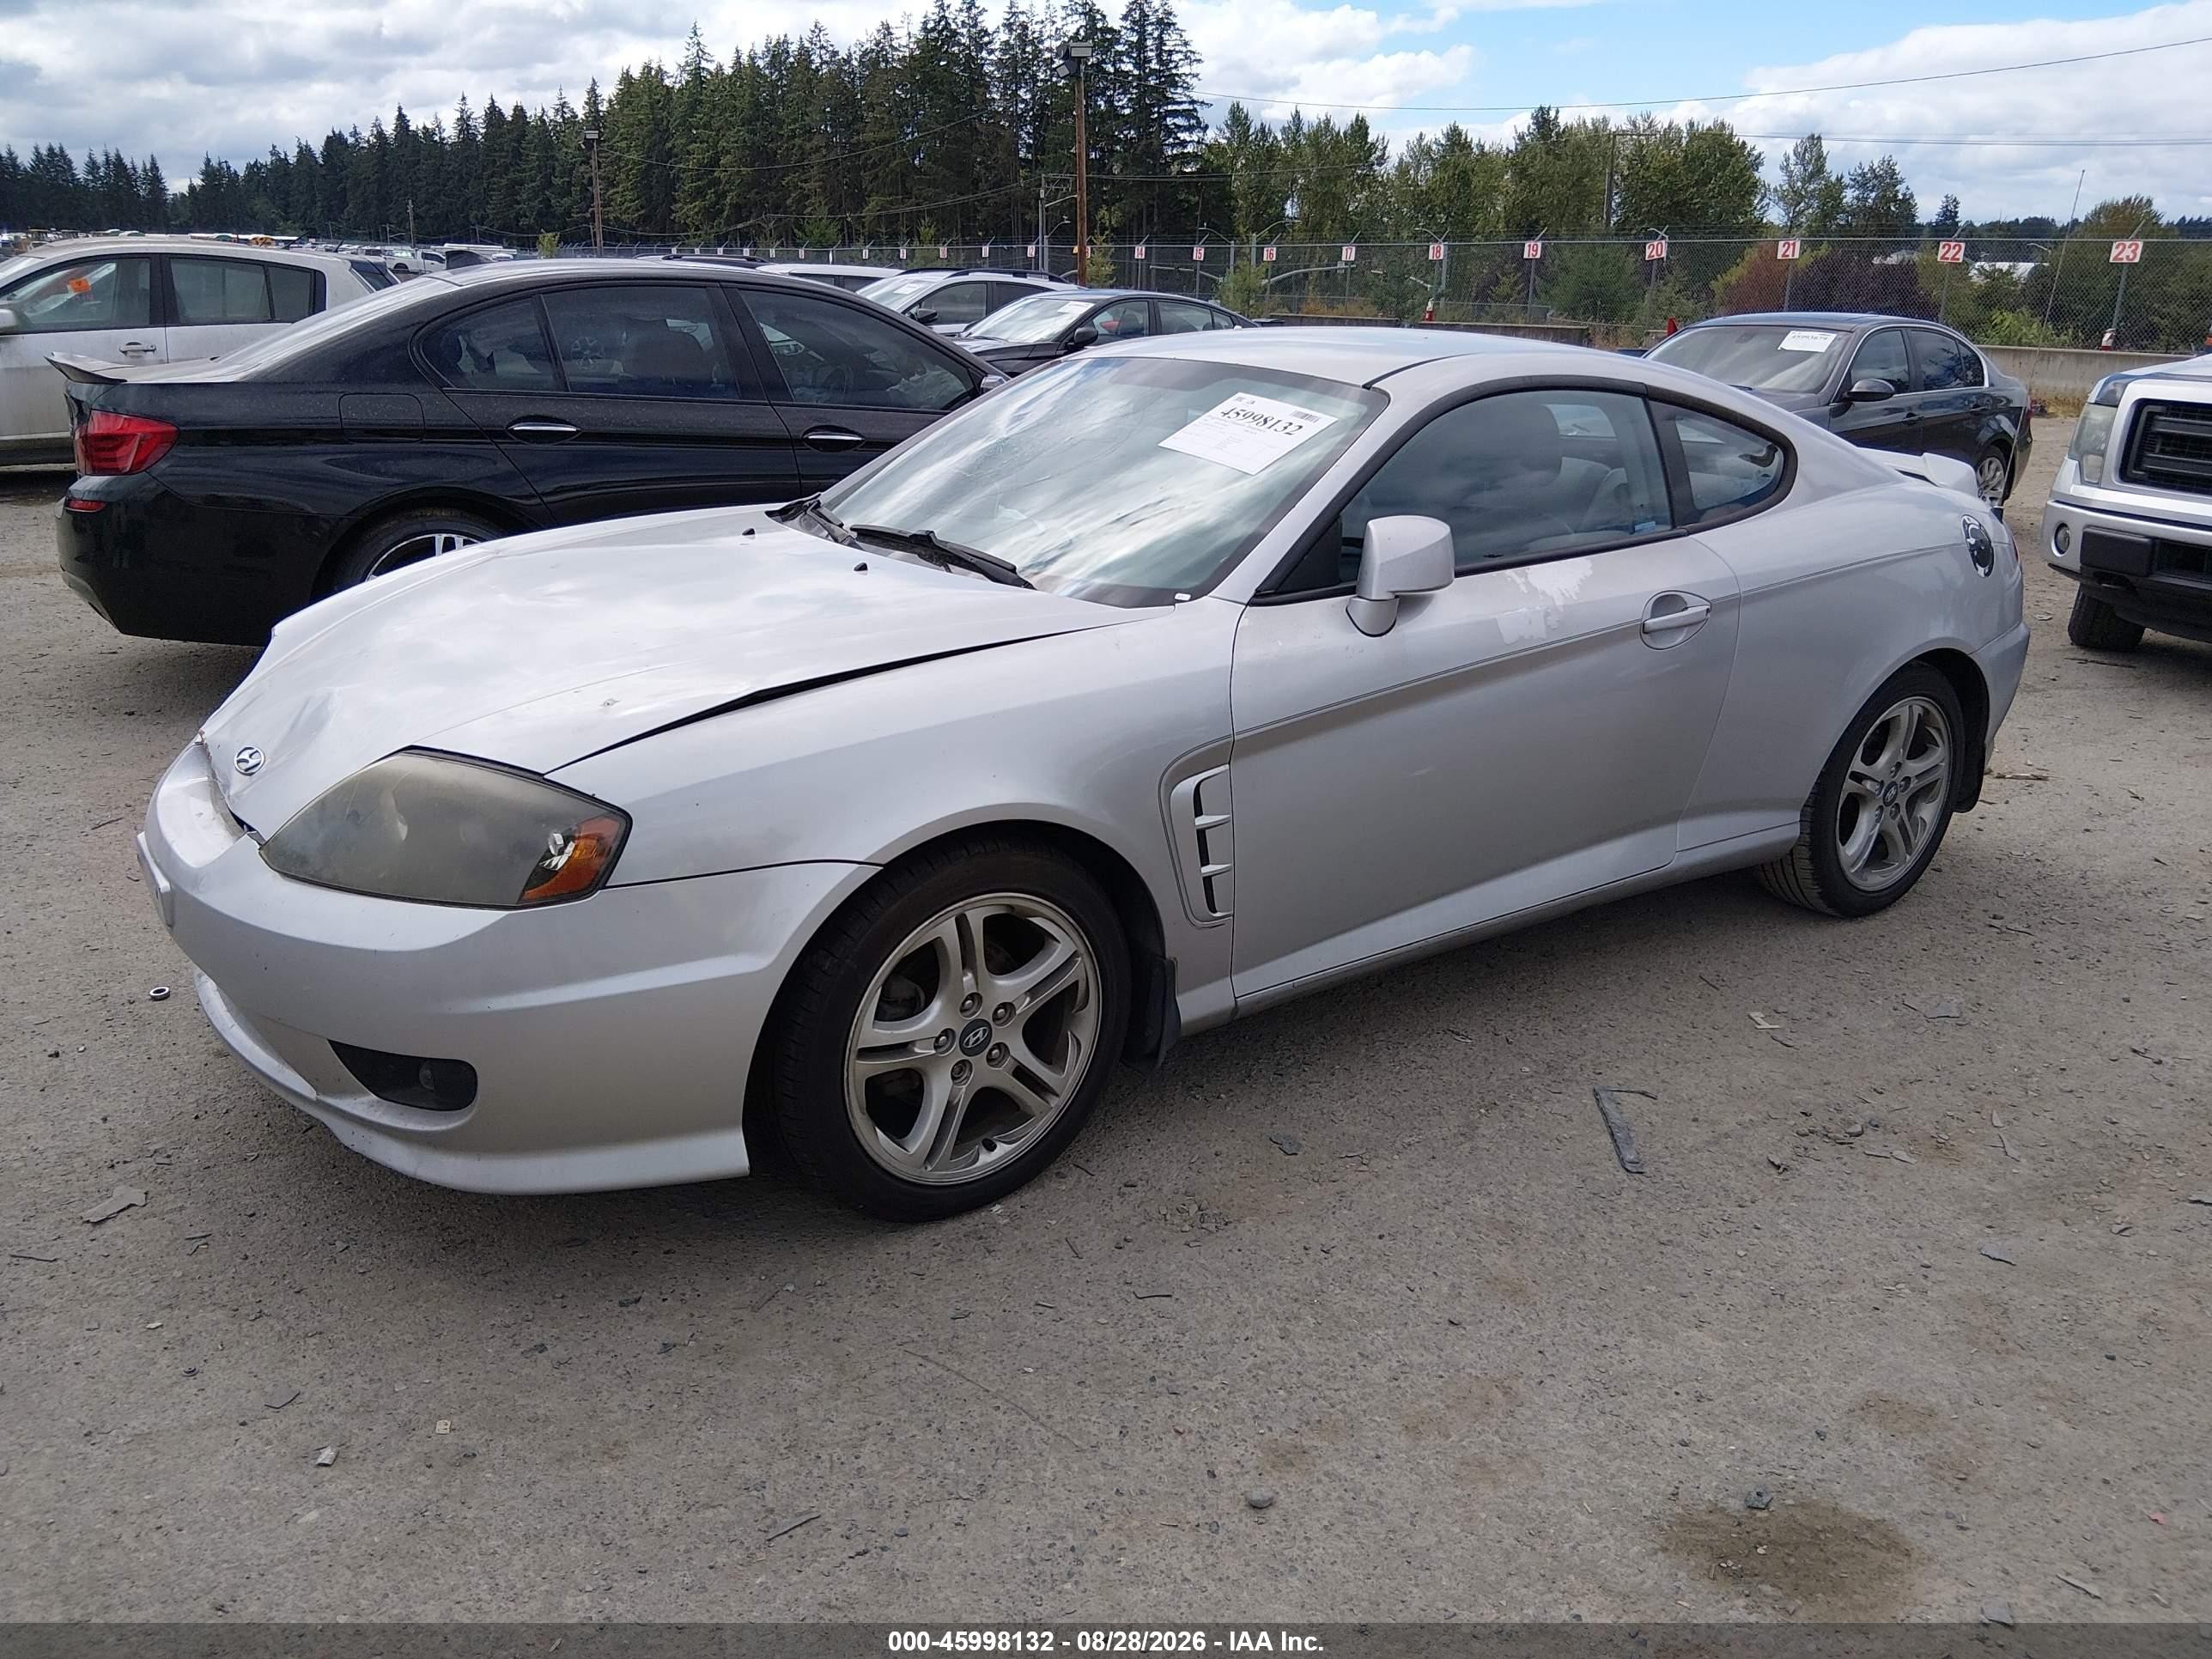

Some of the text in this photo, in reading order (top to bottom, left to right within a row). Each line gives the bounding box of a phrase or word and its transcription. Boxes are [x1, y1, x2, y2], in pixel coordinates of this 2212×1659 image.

[1137, 247, 1144, 258] 14
[1195, 247, 1202, 259] 15
[1266, 248, 1274, 260] 16
[1346, 248, 1352, 260] 17
[1431, 246, 1441, 258] 18
[1528, 244, 1538, 257] 19
[1648, 242, 1663, 258] 20
[1782, 242, 1796, 258] 21
[1940, 243, 1962, 261] 22
[2112, 243, 2139, 261] 23
[1221, 407, 1304, 435] 45998132
